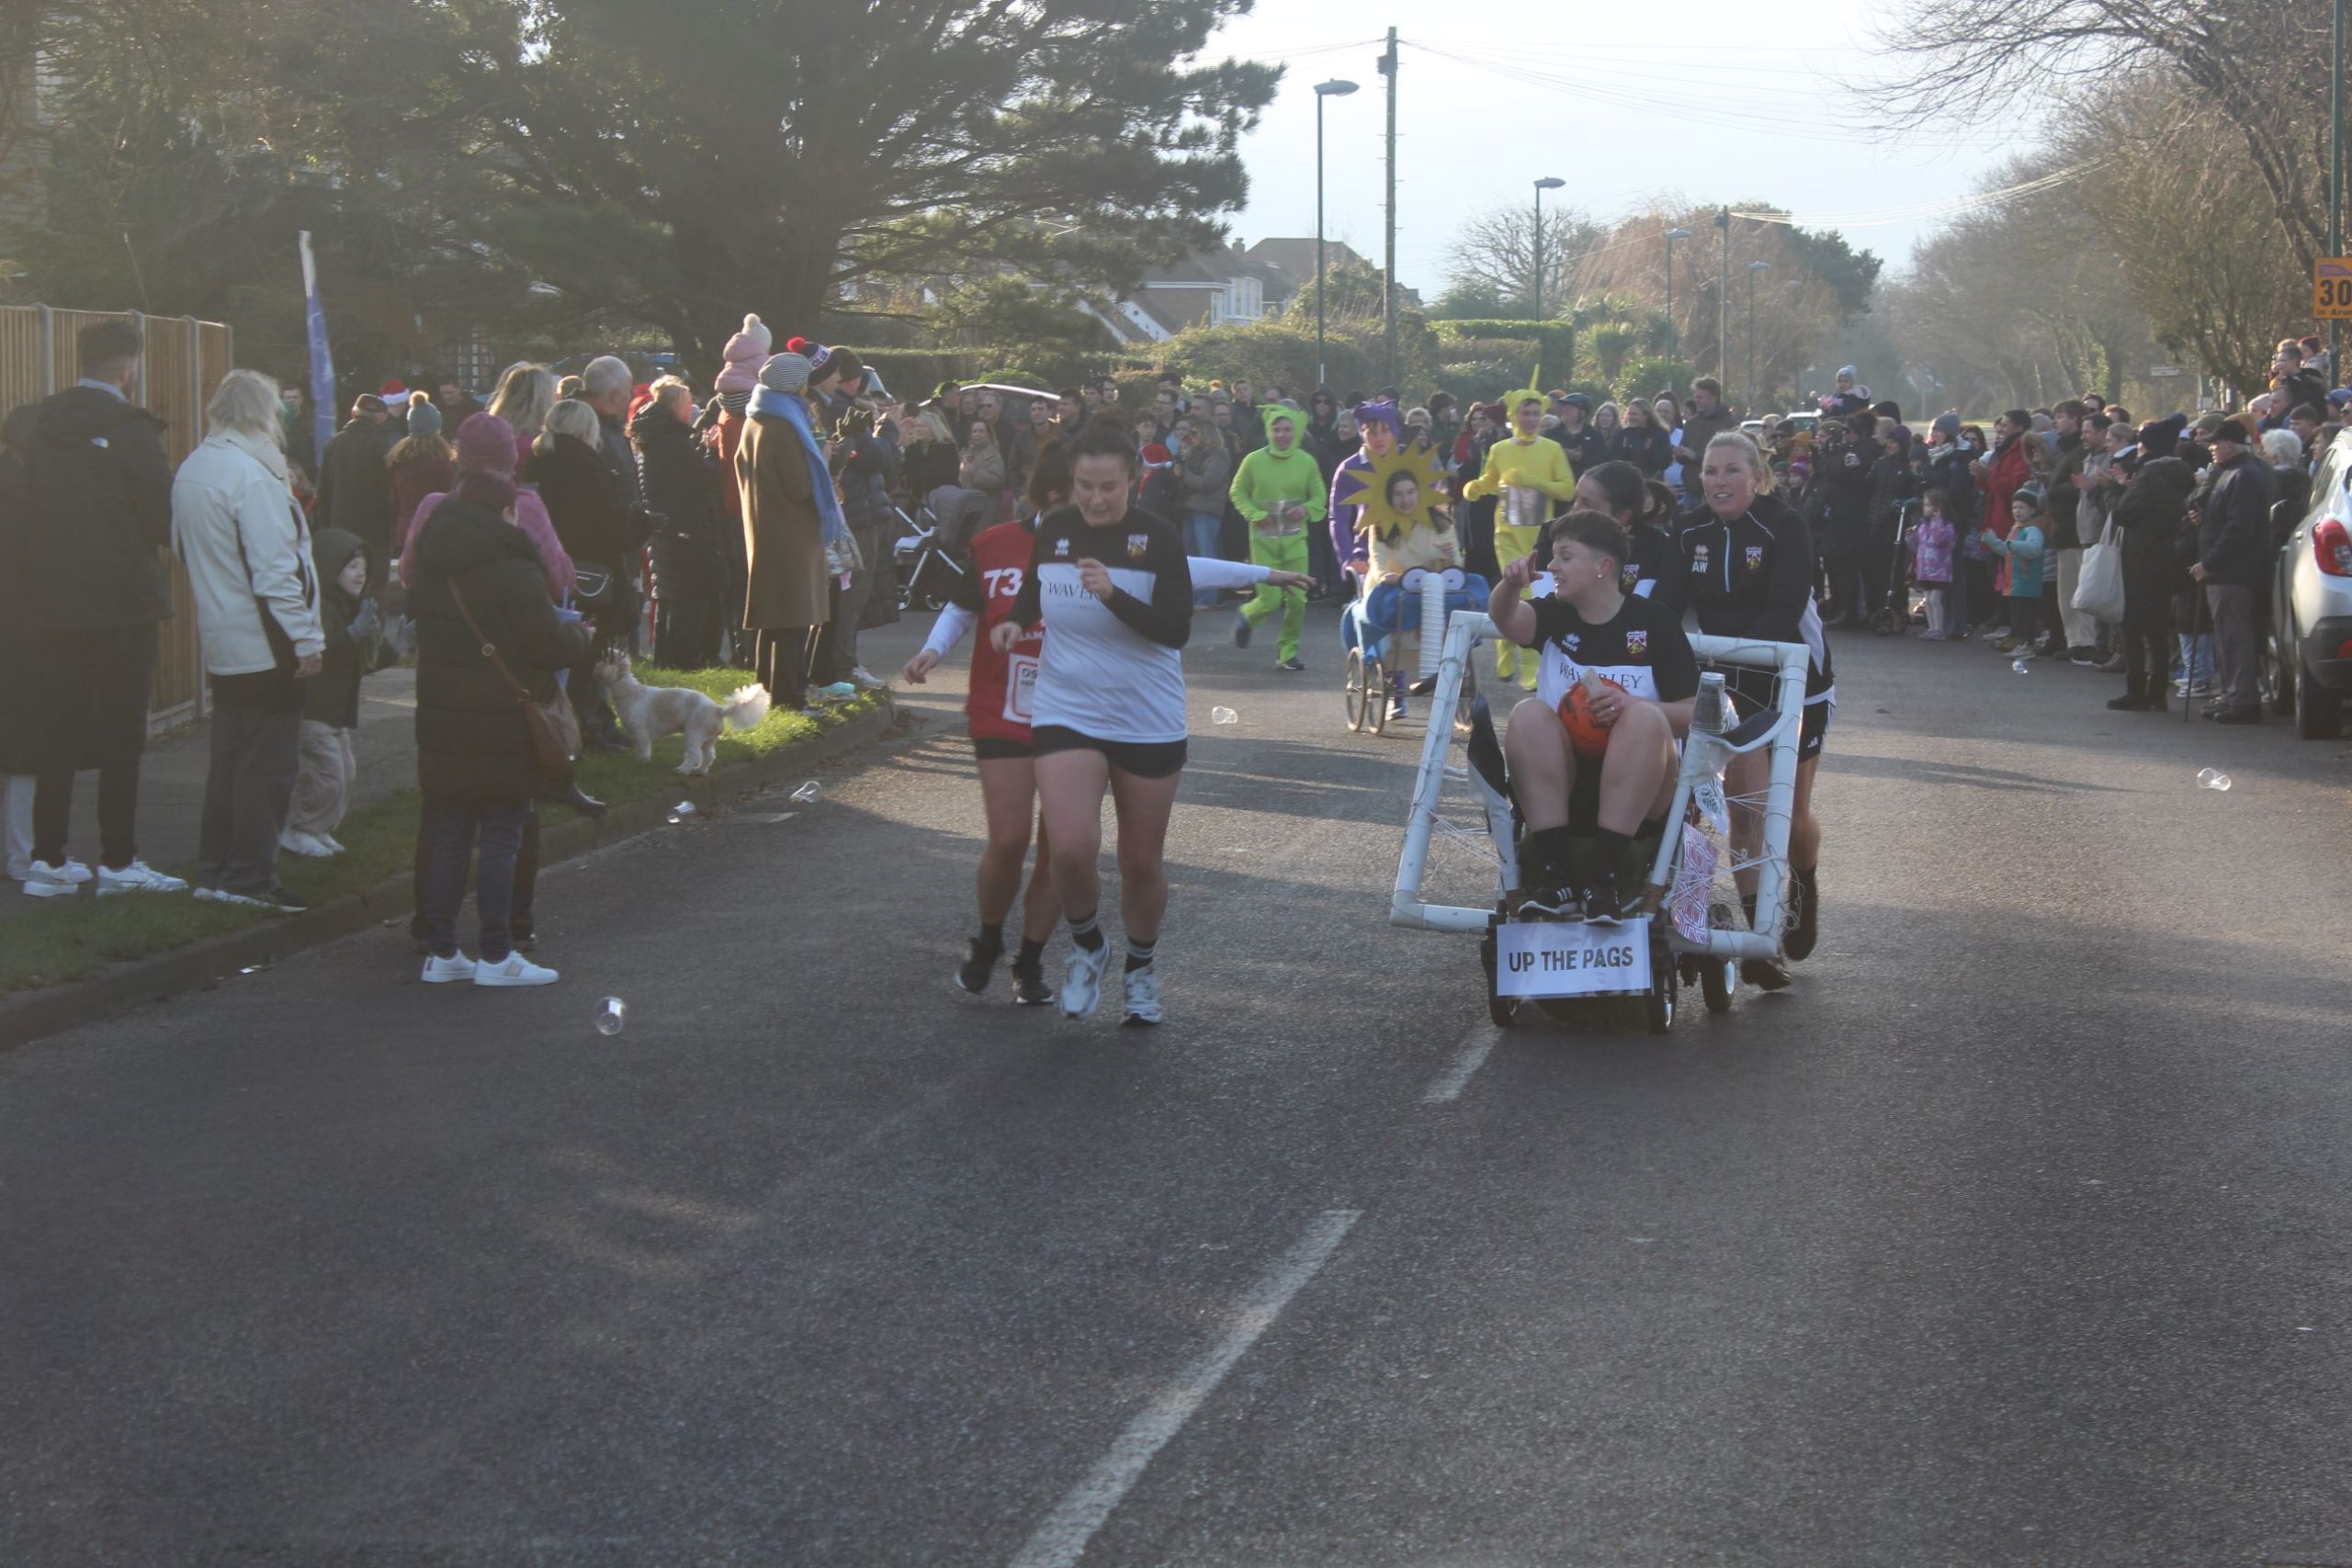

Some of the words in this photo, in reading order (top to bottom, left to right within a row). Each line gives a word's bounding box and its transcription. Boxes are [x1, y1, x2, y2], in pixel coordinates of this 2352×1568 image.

[2320, 279, 2352, 307] 30
[1691, 560, 1709, 573] AW
[983, 568, 1023, 599] 73
[1509, 952, 1535, 973] UP
[1541, 950, 1578, 971] THE
[1583, 946, 1634, 969] PAGS
